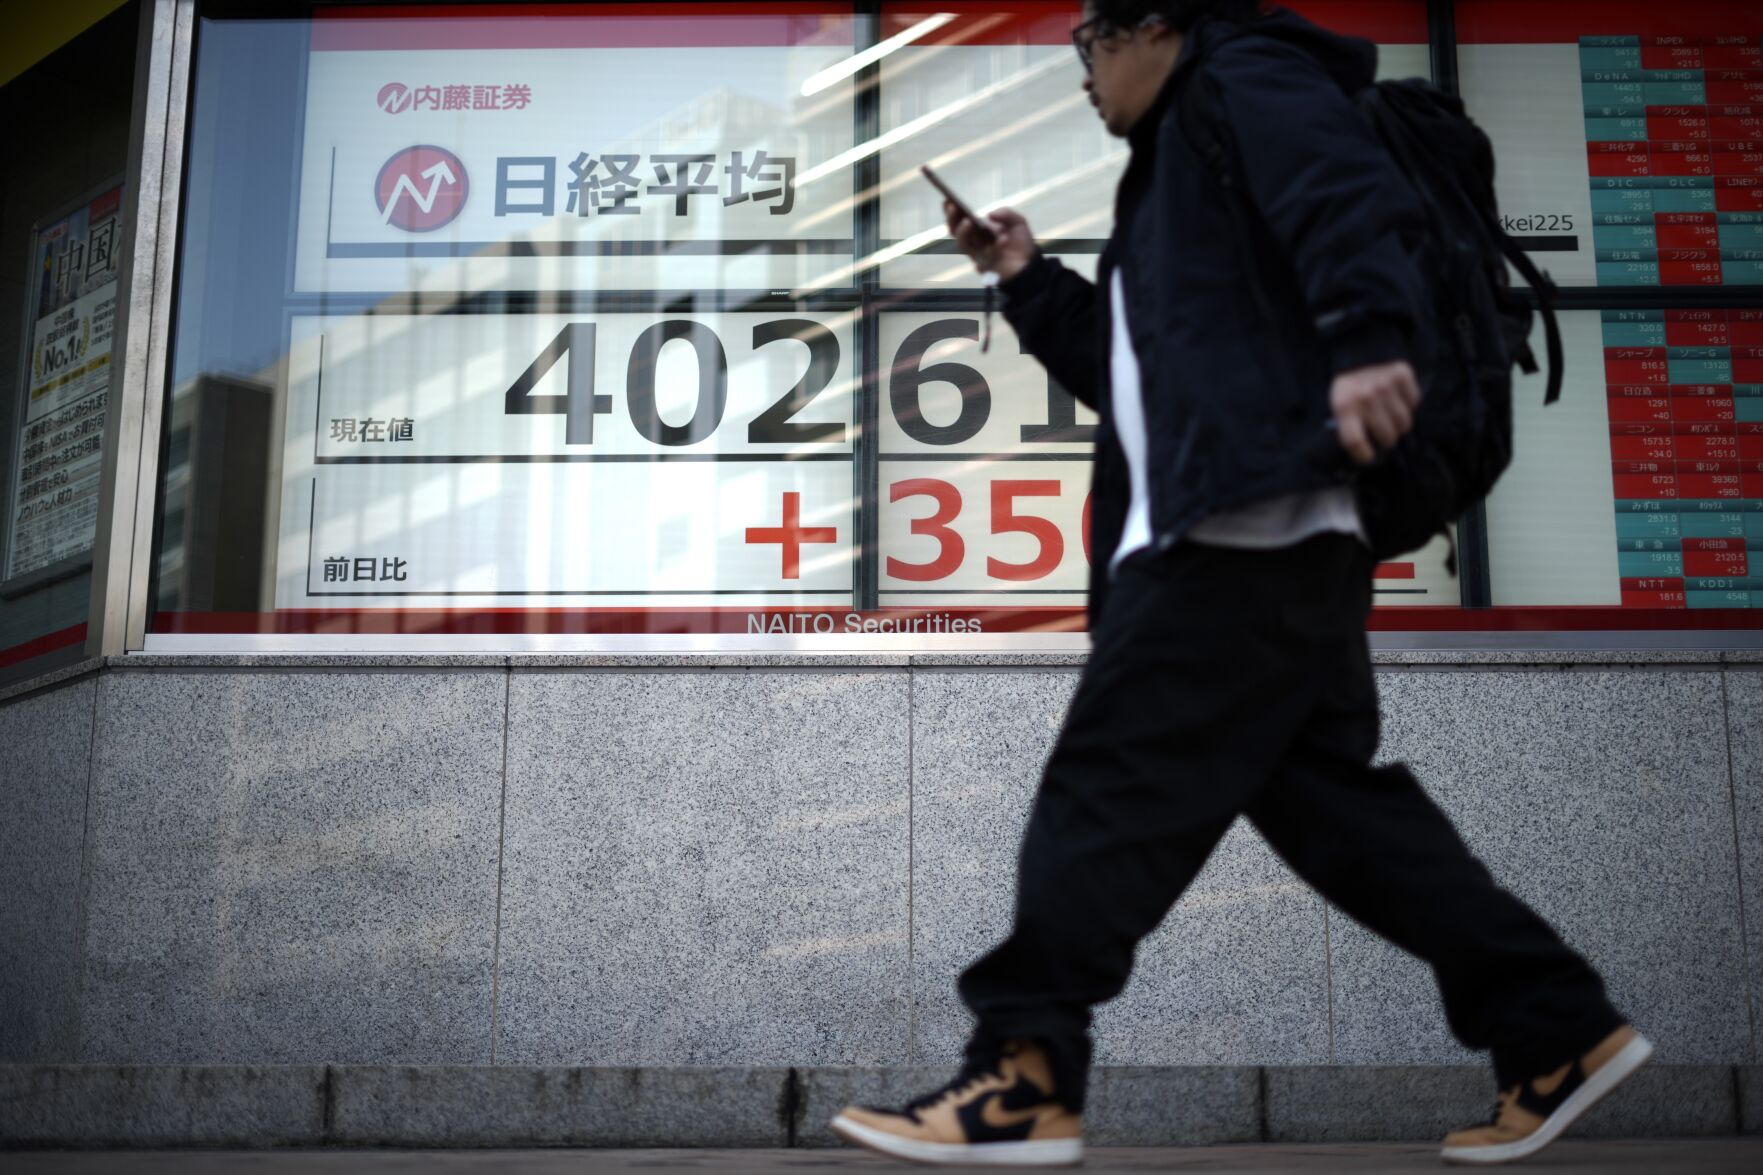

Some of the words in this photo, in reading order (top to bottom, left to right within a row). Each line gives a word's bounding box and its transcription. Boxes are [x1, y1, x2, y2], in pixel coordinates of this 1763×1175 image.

[1595, 72, 1629, 80] DeNA
[413, 84, 532, 112] 内藤証券
[494, 150, 796, 217] 日経平均
[1499, 214, 1573, 231] kei225
[56, 216, 121, 294] 中国
[1672, 251, 1707, 259] フジクラ
[43, 334, 81, 375] No.1!
[1616, 349, 1654, 357] シャープ
[329, 417, 415, 443] 現在値
[1624, 425, 1655, 434] ニコン
[1642, 438, 1672, 446] 1573.5
[1648, 450, 1672, 458] +34.0
[1652, 476, 1674, 484] 6723
[322, 556, 407, 582] 前日比
[1638, 580, 1665, 588] NTT
[1699, 579, 1734, 588] KDDI
[747, 612, 834, 633] NAITO
[844, 612, 982, 633] Securities
